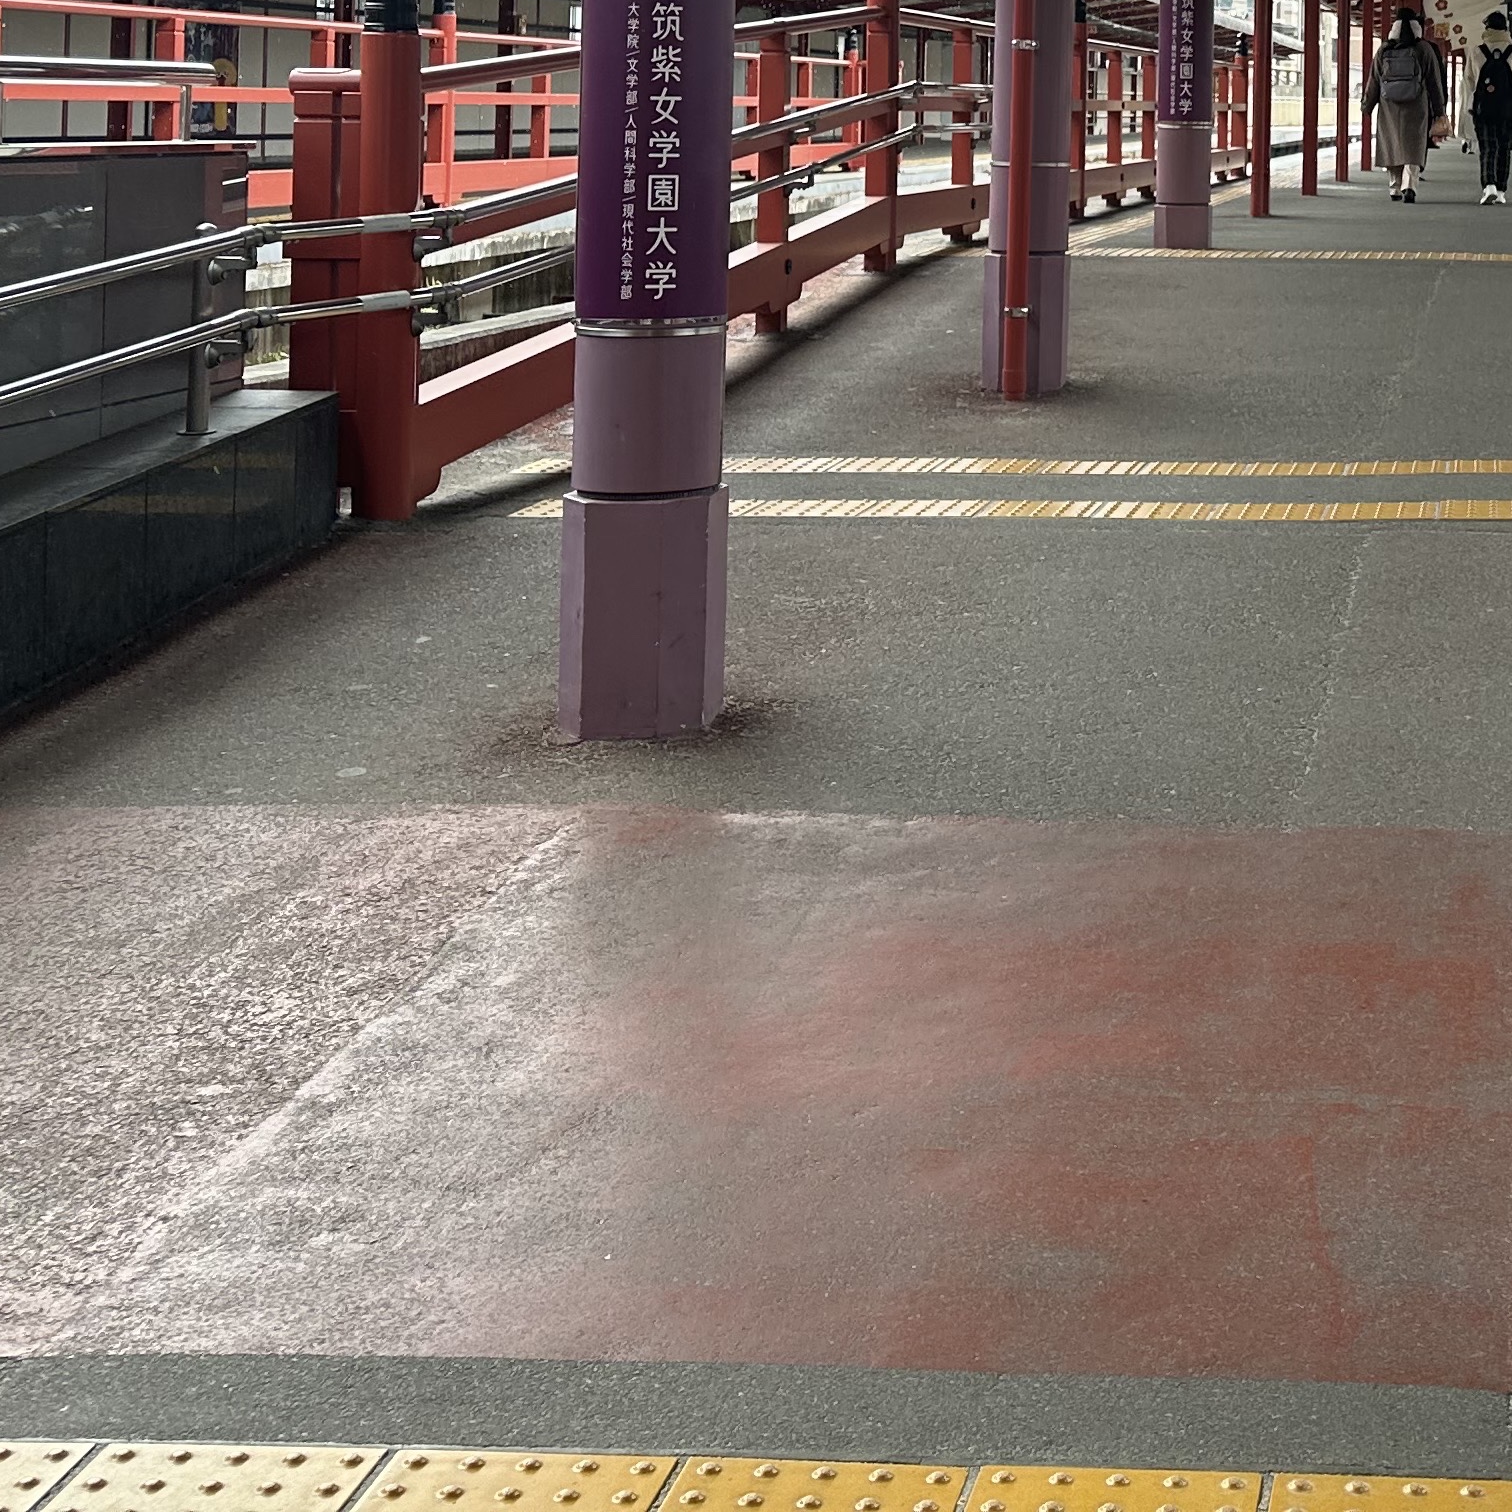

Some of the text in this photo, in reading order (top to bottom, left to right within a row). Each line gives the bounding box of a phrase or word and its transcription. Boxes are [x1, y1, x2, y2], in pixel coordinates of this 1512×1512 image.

[644, 1, 685, 300] 筑紫女学園大学
